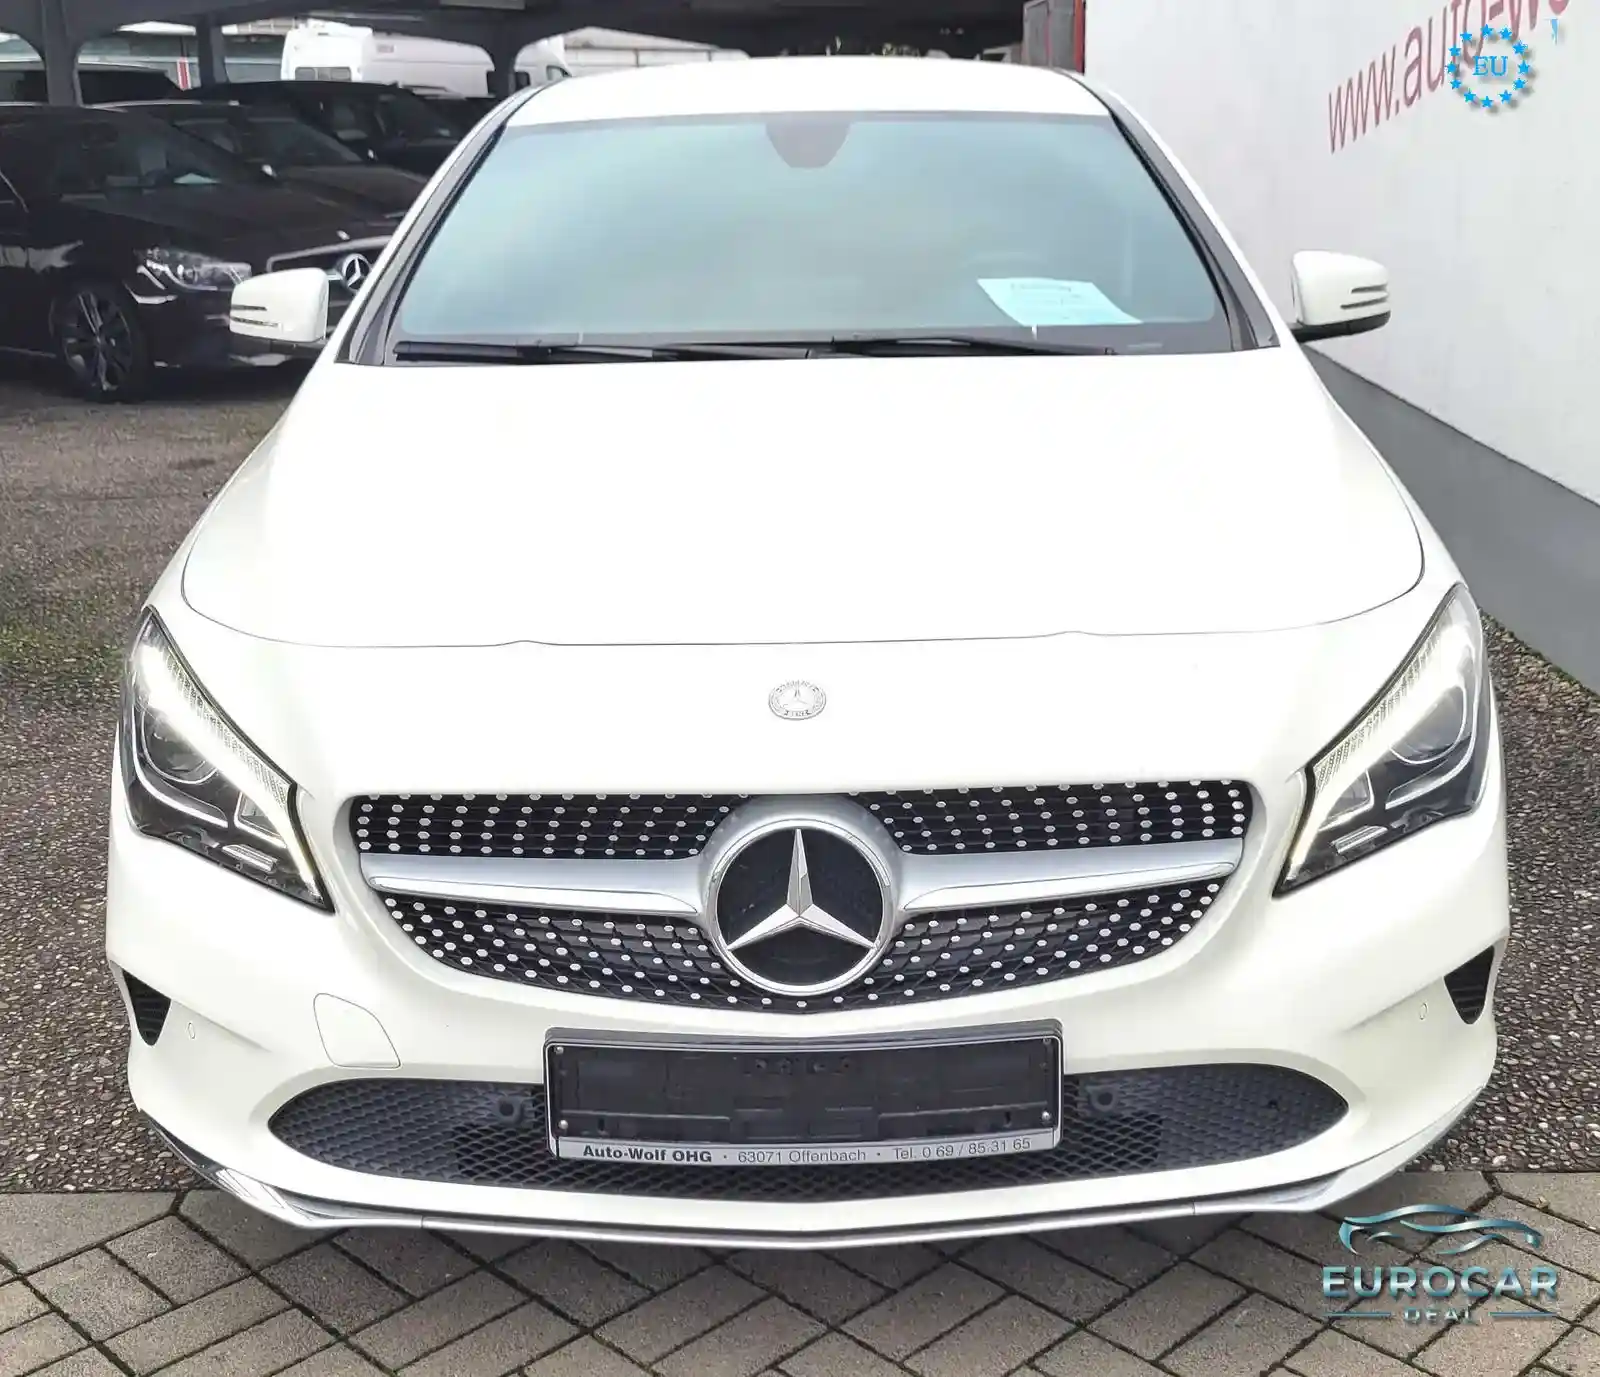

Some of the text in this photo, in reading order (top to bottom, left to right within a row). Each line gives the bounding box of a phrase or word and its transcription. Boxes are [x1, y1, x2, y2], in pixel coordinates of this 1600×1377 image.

[1328, 0, 1570, 155] www.auto-
[583, 1144, 667, 1162] Auto-Wolf
[672, 1150, 712, 1162] OHG
[738, 1151, 782, 1163] 63071
[789, 1149, 866, 1163] Offenbach
[894, 1147, 917, 1160] Tel.
